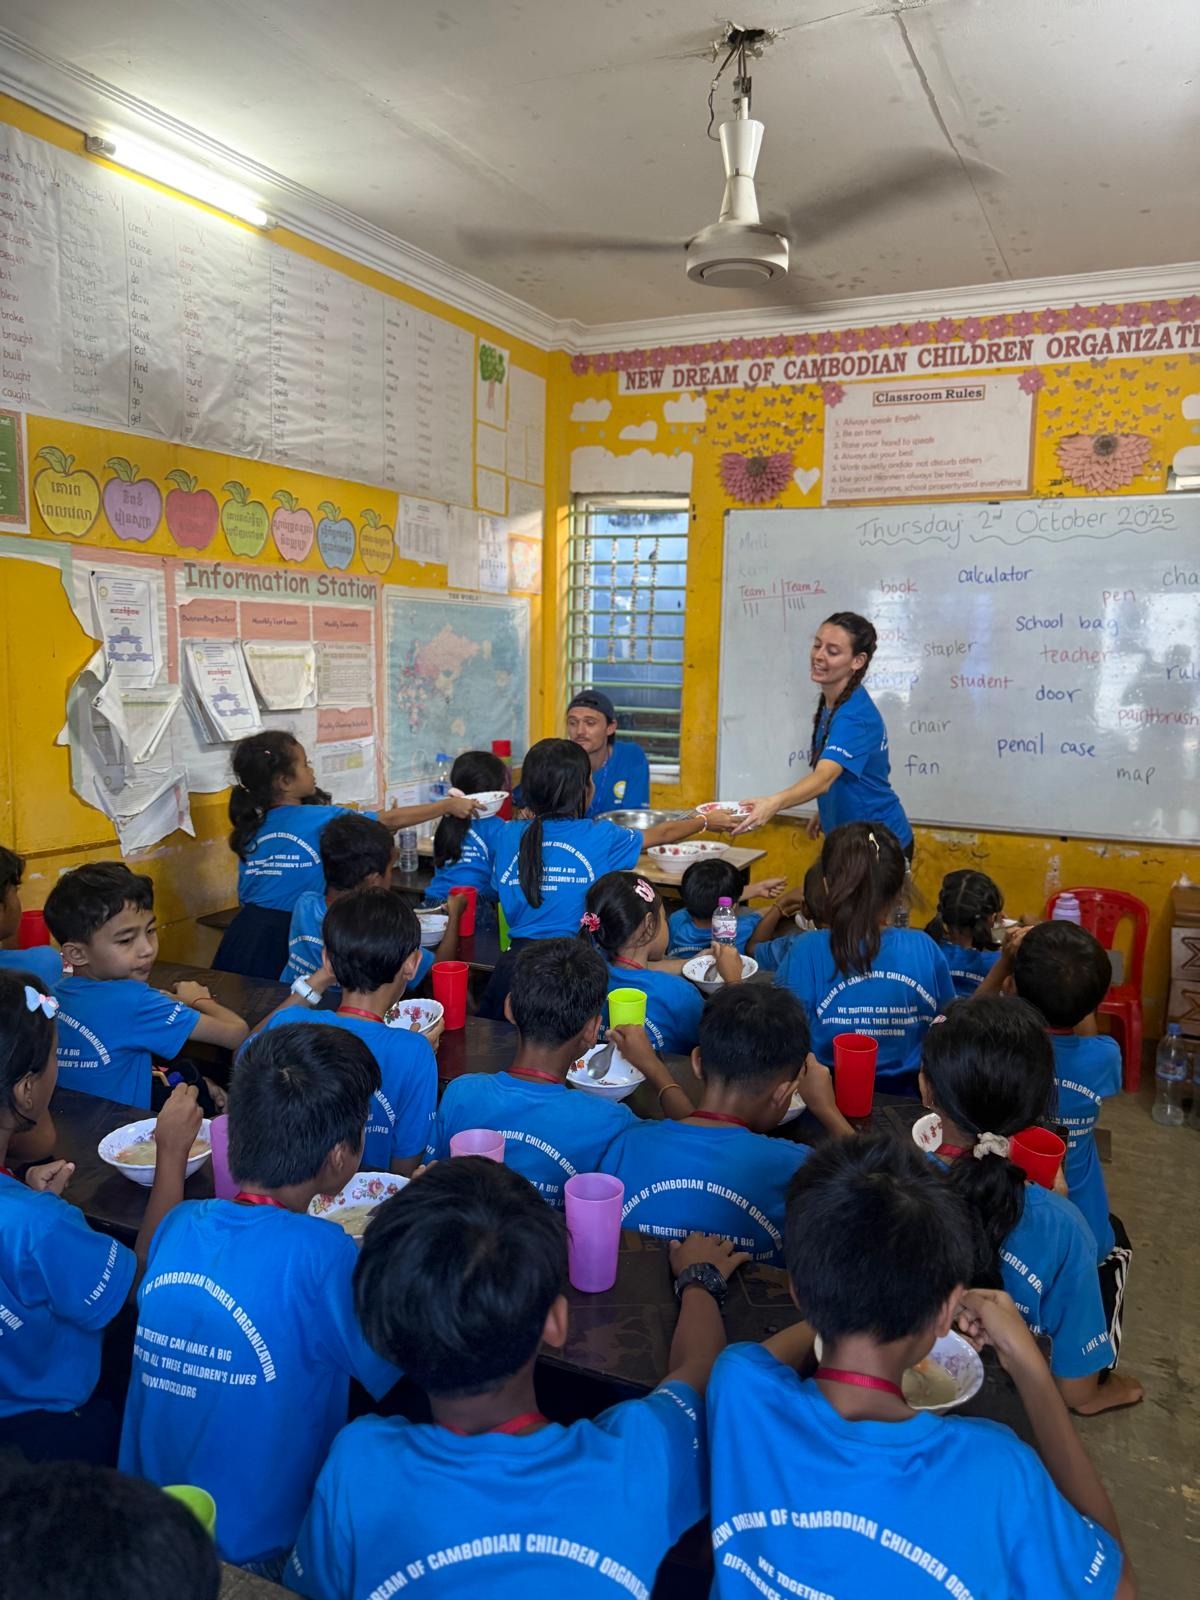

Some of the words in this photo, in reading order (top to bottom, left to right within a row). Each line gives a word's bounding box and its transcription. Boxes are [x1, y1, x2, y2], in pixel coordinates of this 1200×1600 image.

[625, 369, 664, 390] NEW
[672, 365, 739, 388] DREAM
[748, 361, 775, 382] OF
[783, 352, 908, 381] CAMBODIAN
[917, 339, 1034, 369] CHILDREN
[875, 389, 943, 403] Classroom
[945, 388, 982, 400] Rules
[856, 513, 961, 550] Thursday
[1016, 508, 1108, 534] October
[1118, 506, 1176, 527] 2025
[184, 562, 310, 595] Information
[317, 574, 377, 600] Station
[880, 578, 918, 593] book
[958, 565, 1034, 585] calculator
[738, 585, 766, 599] Team
[785, 580, 812, 593] Team
[814, 580, 827, 594] 2
[1102, 589, 1136, 607] pen
[877, 625, 908, 643] ook
[1079, 616, 1120, 637] bag
[924, 640, 978, 658] stapler
[1041, 644, 1113, 664] teacher
[950, 675, 1013, 690] student
[1036, 685, 1081, 703] door
[910, 720, 951, 736] chair
[997, 732, 1044, 759] pencil
[1061, 741, 1096, 757] case
[905, 755, 940, 776] fan
[1117, 767, 1156, 785] map
[886, 970, 917, 988] CHILDREN
[69, 1049, 81, 1057] BIG
[80, 1060, 99, 1069] LIVES
[1061, 1079, 1096, 1100] CHILDREN
[525, 1134, 561, 1161] CHILDREN
[539, 1182, 545, 1191] A
[546, 1183, 559, 1193] BIG
[640, 1187, 650, 1200] OF
[651, 1178, 704, 1195] CAMBODIAN
[706, 1182, 749, 1210] CHILDREN
[638, 1223, 651, 1234] WE
[652, 1225, 688, 1239] TOGETHER
[740, 1237, 755, 1247] BIG
[90, 1280, 107, 1301] LOVE
[102, 1267, 112, 1282] MY
[154, 1271, 206, 1289] CAMBODIAN
[204, 1277, 236, 1311] CHILDREN
[232, 1306, 277, 1383] ORGANIZATION
[169, 1337, 186, 1351] CAN
[185, 1340, 208, 1359] MAKE
[208, 1346, 216, 1359] A
[217, 1348, 233, 1362] BIG
[1085, 1338, 1100, 1353] LOVE
[161, 1357, 182, 1373] THESE
[182, 1362, 229, 1384] CHILDREN'S
[229, 1374, 257, 1386] LIVES
[731, 1511, 768, 1532] DREAM
[770, 1508, 788, 1527] OF
[791, 1510, 879, 1540] CAMBODIAN
[880, 1528, 949, 1582] CHILDREN
[406, 1559, 426, 1580] OF
[427, 1533, 521, 1571] CAMBODIAN
[526, 1533, 600, 1568] CHILDREN
[757, 1555, 776, 1578] WE
[1092, 1550, 1106, 1578] LOVE
[722, 1552, 782, 1600] DIFFERENCE
